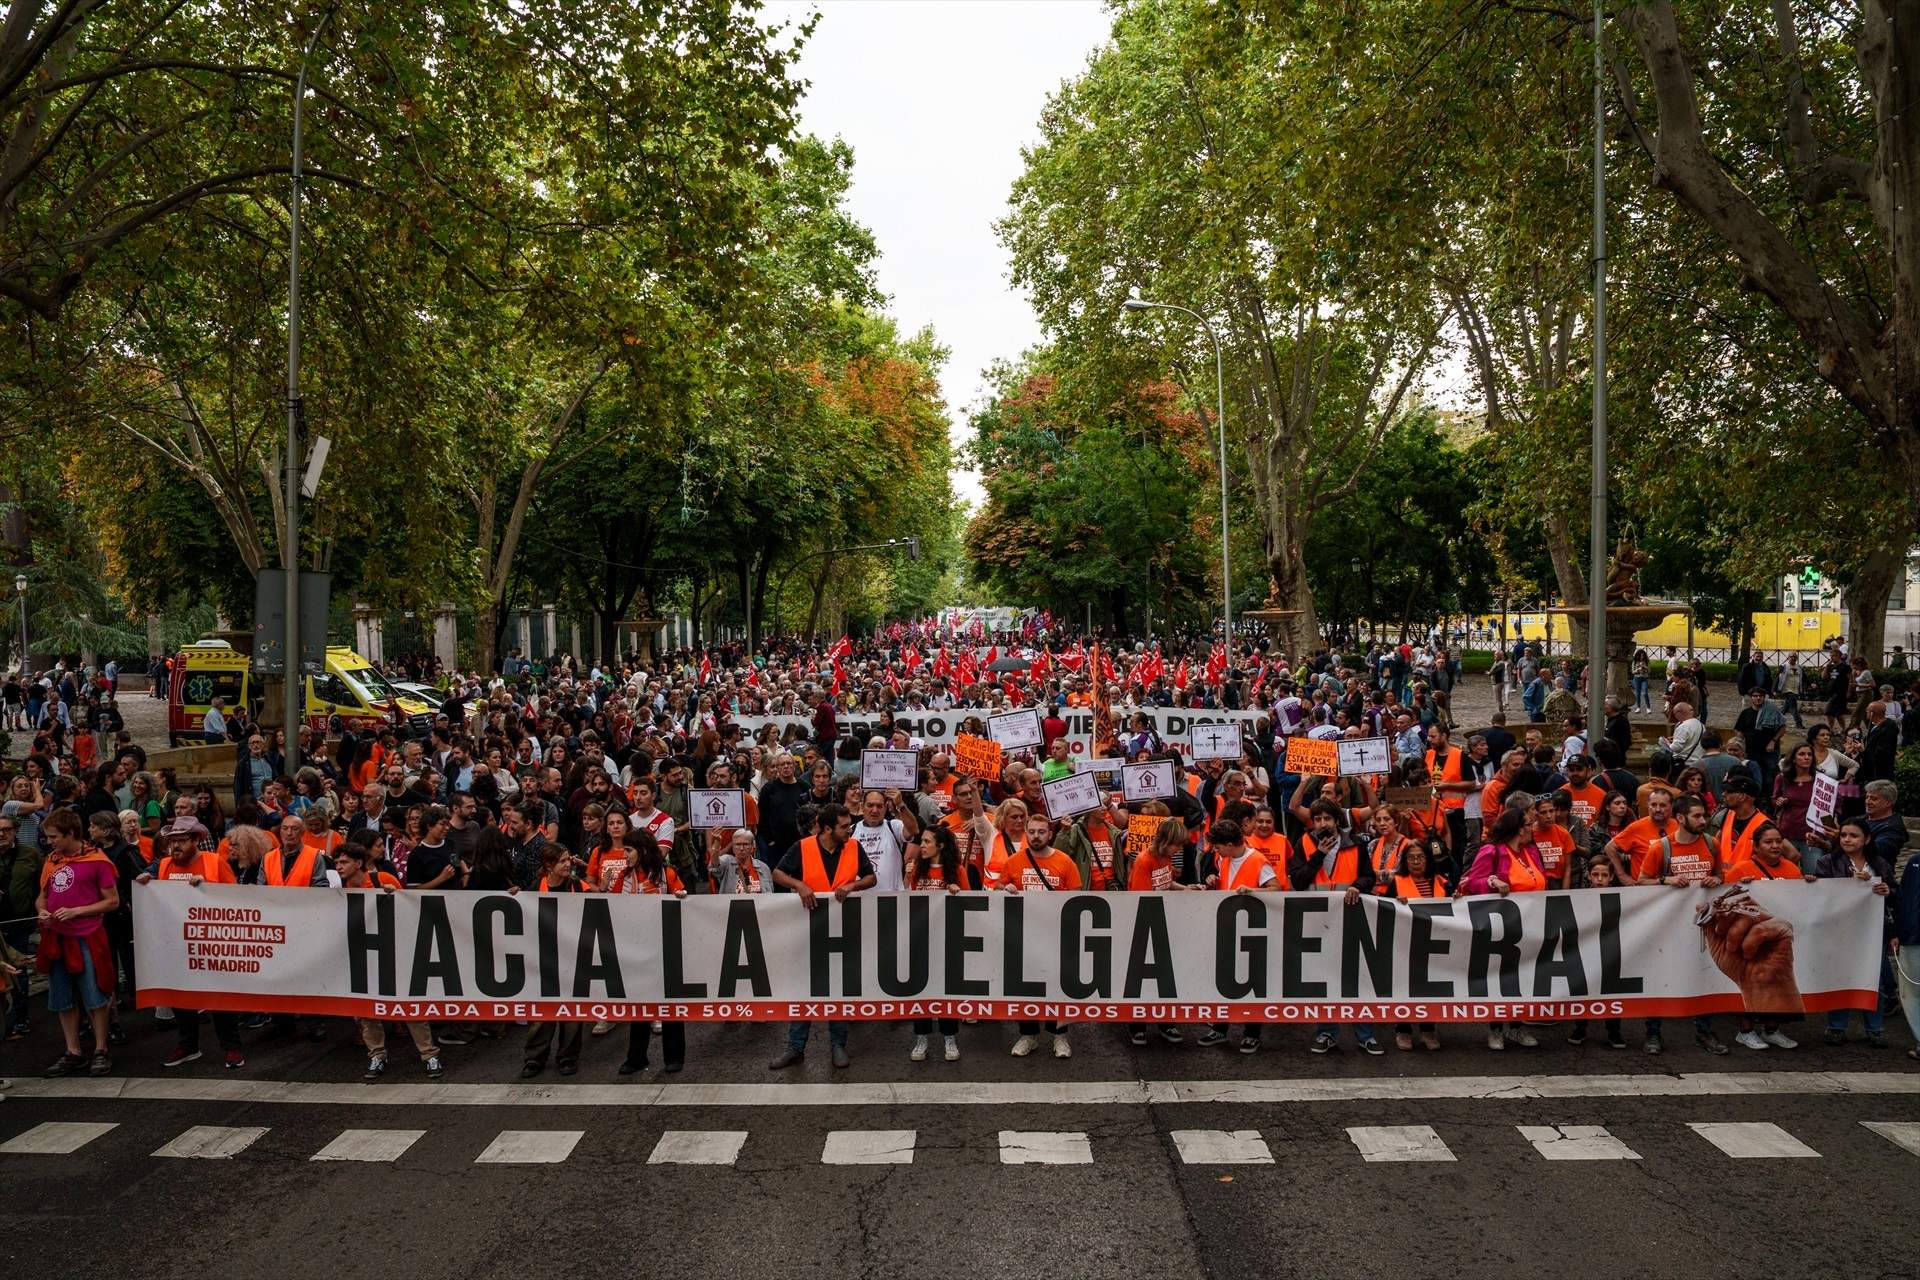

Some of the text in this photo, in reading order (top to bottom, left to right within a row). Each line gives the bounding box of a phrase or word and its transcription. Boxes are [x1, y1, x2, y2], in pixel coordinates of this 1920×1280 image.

[1290, 739, 1333, 752] Brookfield
[1287, 754, 1331, 766] ESTAS CASAS
[1288, 763, 1336, 775] SON NUESTRAS
[1130, 843, 1143, 852] EN
[188, 907, 261, 922] SINDICATO
[187, 925, 283, 941] DE INQUILINAS
[187, 943, 273, 958] E INQUILINOS
[347, 892, 1643, 999] HACIA LA HUELGA GENERAL
[189, 958, 260, 973] DE MADRID
[375, 1003, 480, 1017] BAJADA
[493, 1004, 543, 1017] DEL
[556, 1004, 689, 1020] ALQUILER
[702, 1004, 753, 1017] 50%
[788, 1000, 993, 1017] EXPROPIACIÓN
[1008, 1003, 1118, 1018] FONDOS
[1132, 1006, 1229, 1019] BUITRE
[1264, 1005, 1428, 1019] CONTRATOS
[1442, 1001, 1623, 1018] INDEFINIDOS
